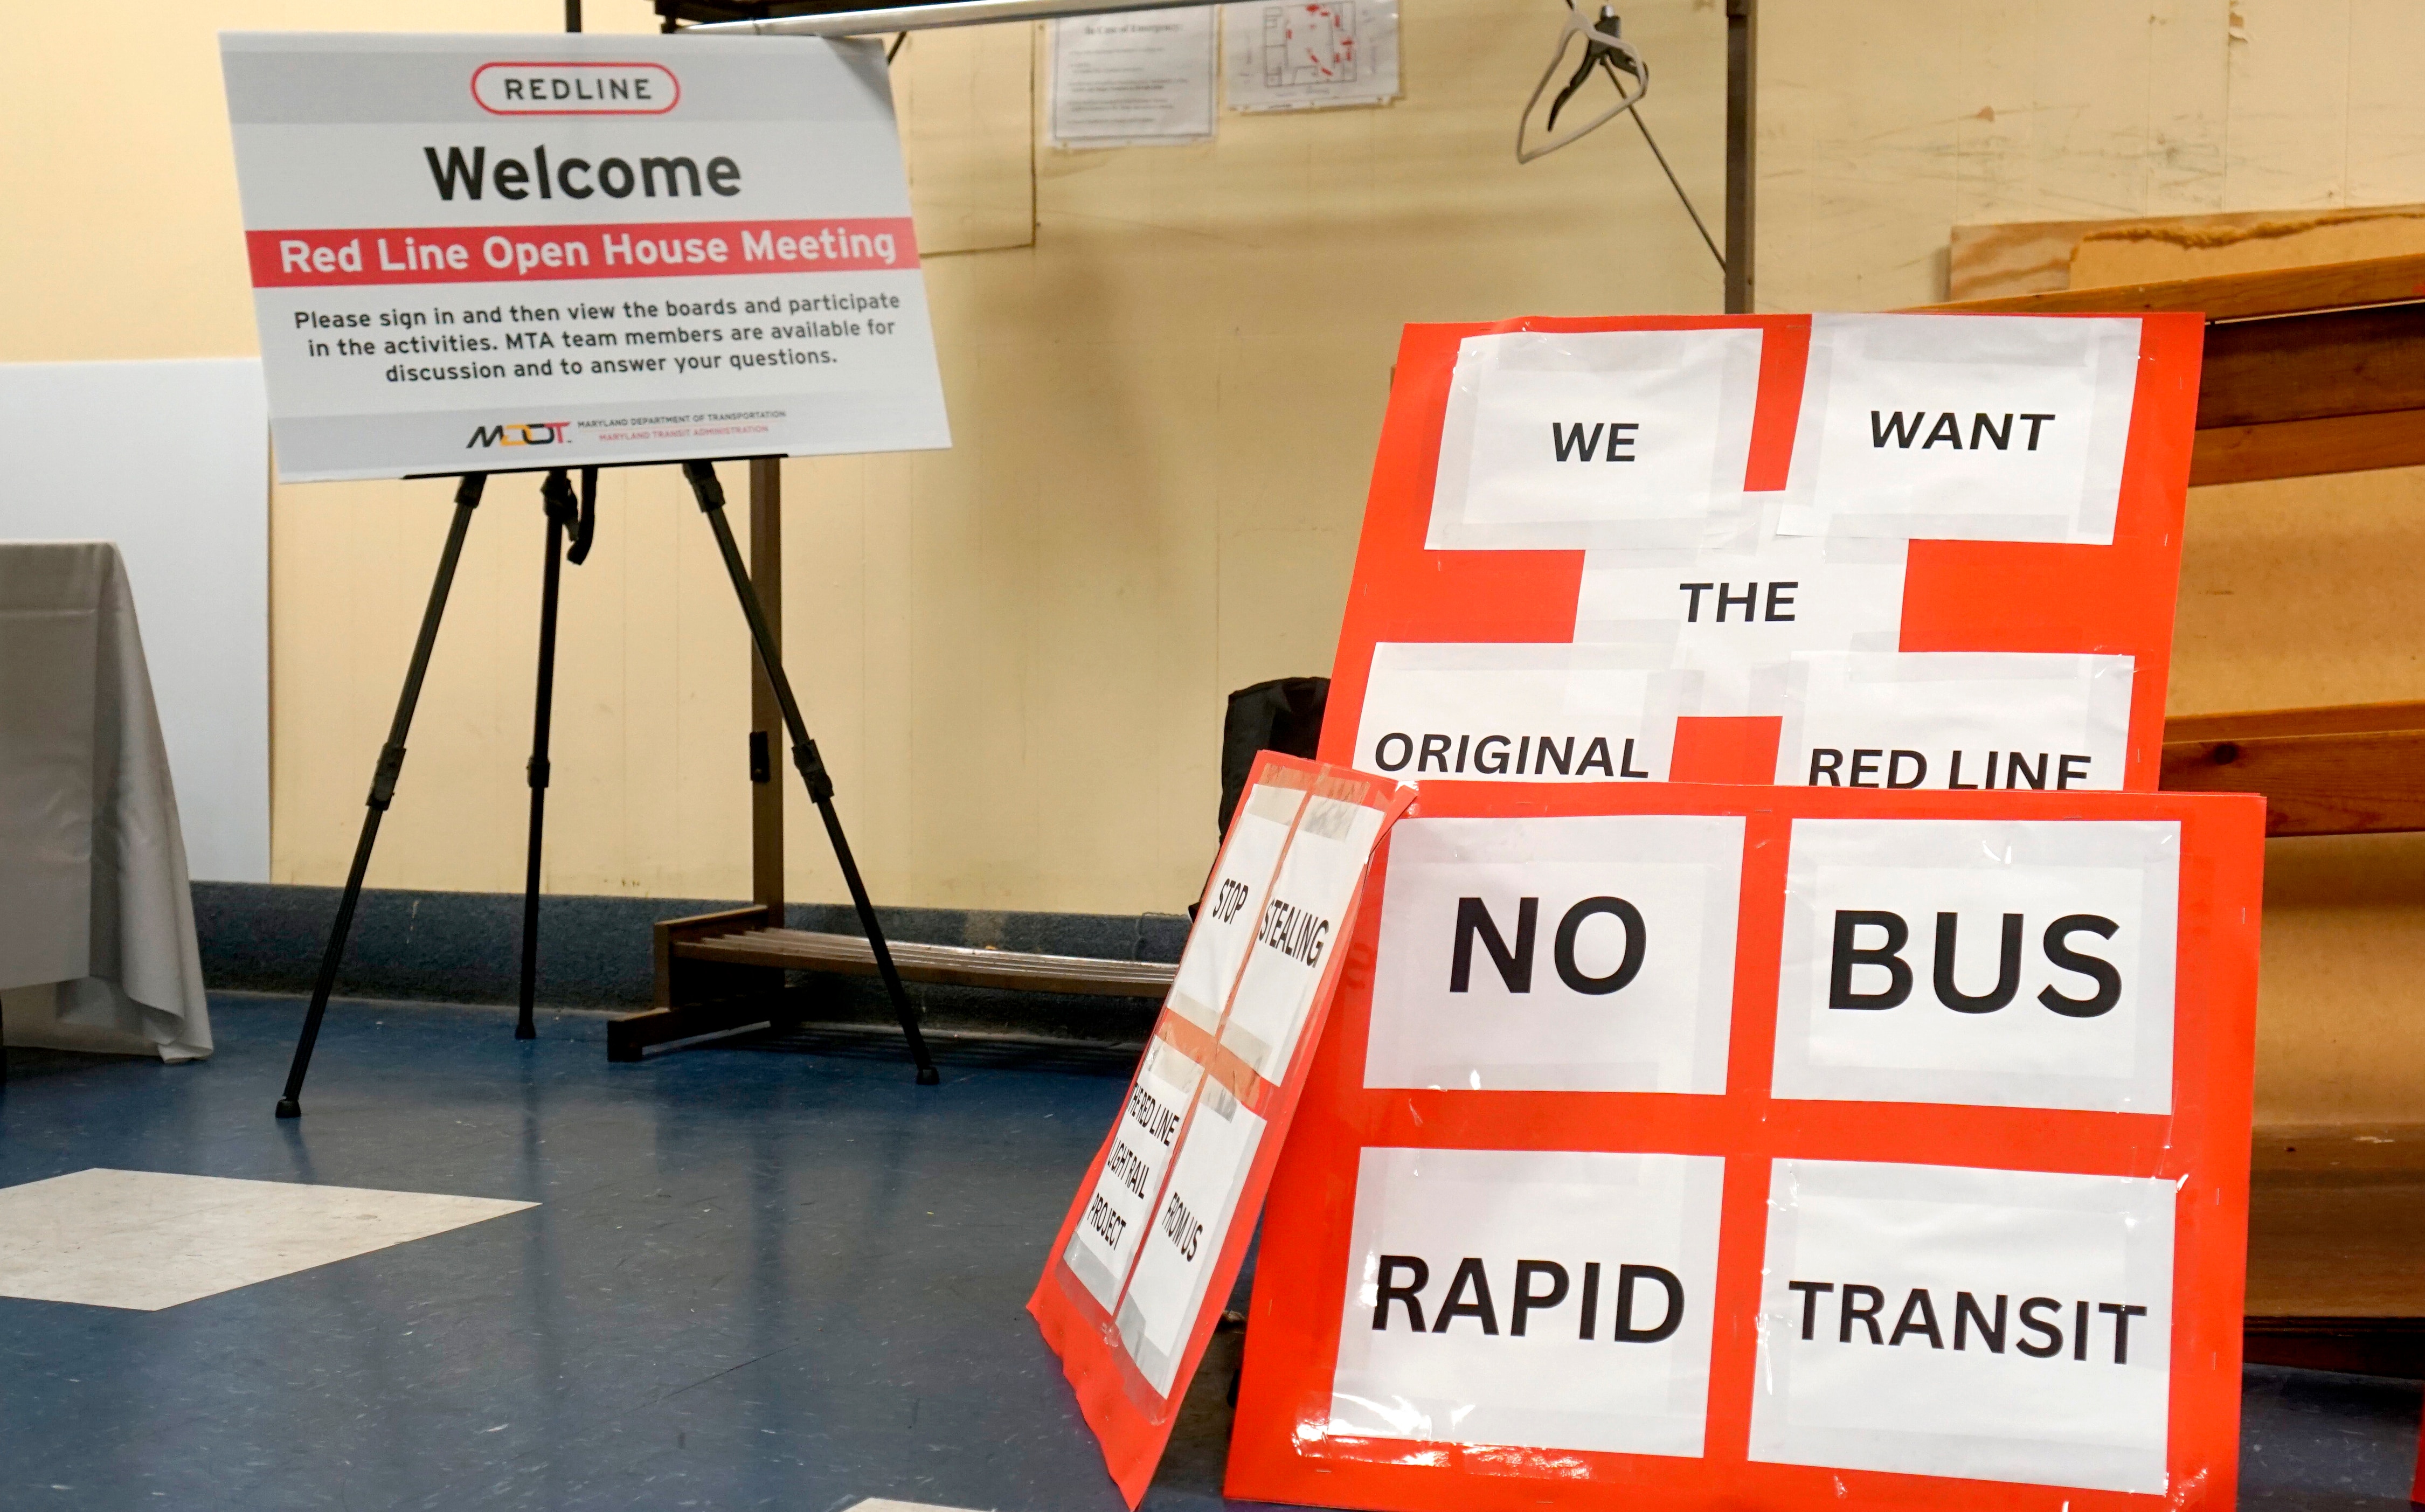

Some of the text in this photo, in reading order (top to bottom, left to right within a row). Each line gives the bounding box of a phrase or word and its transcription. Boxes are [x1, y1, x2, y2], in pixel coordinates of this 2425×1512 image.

[504, 78, 652, 101] REDLINE
[422, 143, 741, 202] Welcome
[280, 226, 897, 275] Red Line Open House Meeting
[294, 293, 899, 330] Please sign in and then view the boards and participate
[308, 318, 895, 357] in the activities. MTA team members are available for
[385, 349, 837, 383] discussion and to answer your questions.
[577, 411, 787, 429] MARYLAND DEPARTMENT OF TRANSPORTATION
[1552, 410, 2056, 462] WE WANT
[1679, 581, 1799, 623] THE
[1375, 732, 2092, 790] ORIGINAL RED LINE
[1212, 878, 1329, 968] STOP STEALING
[1449, 896, 2122, 1018] NO BUS
[1135, 1091, 1156, 1128] RED
[1149, 1104, 1180, 1147] LINE
[1107, 1137, 1149, 1200] LIGHT RAIL
[1087, 1192, 1127, 1251] PROJECT
[1161, 1191, 1203, 1263] FROM US
[1371, 1254, 2147, 1365] RAPID TRANSIT
